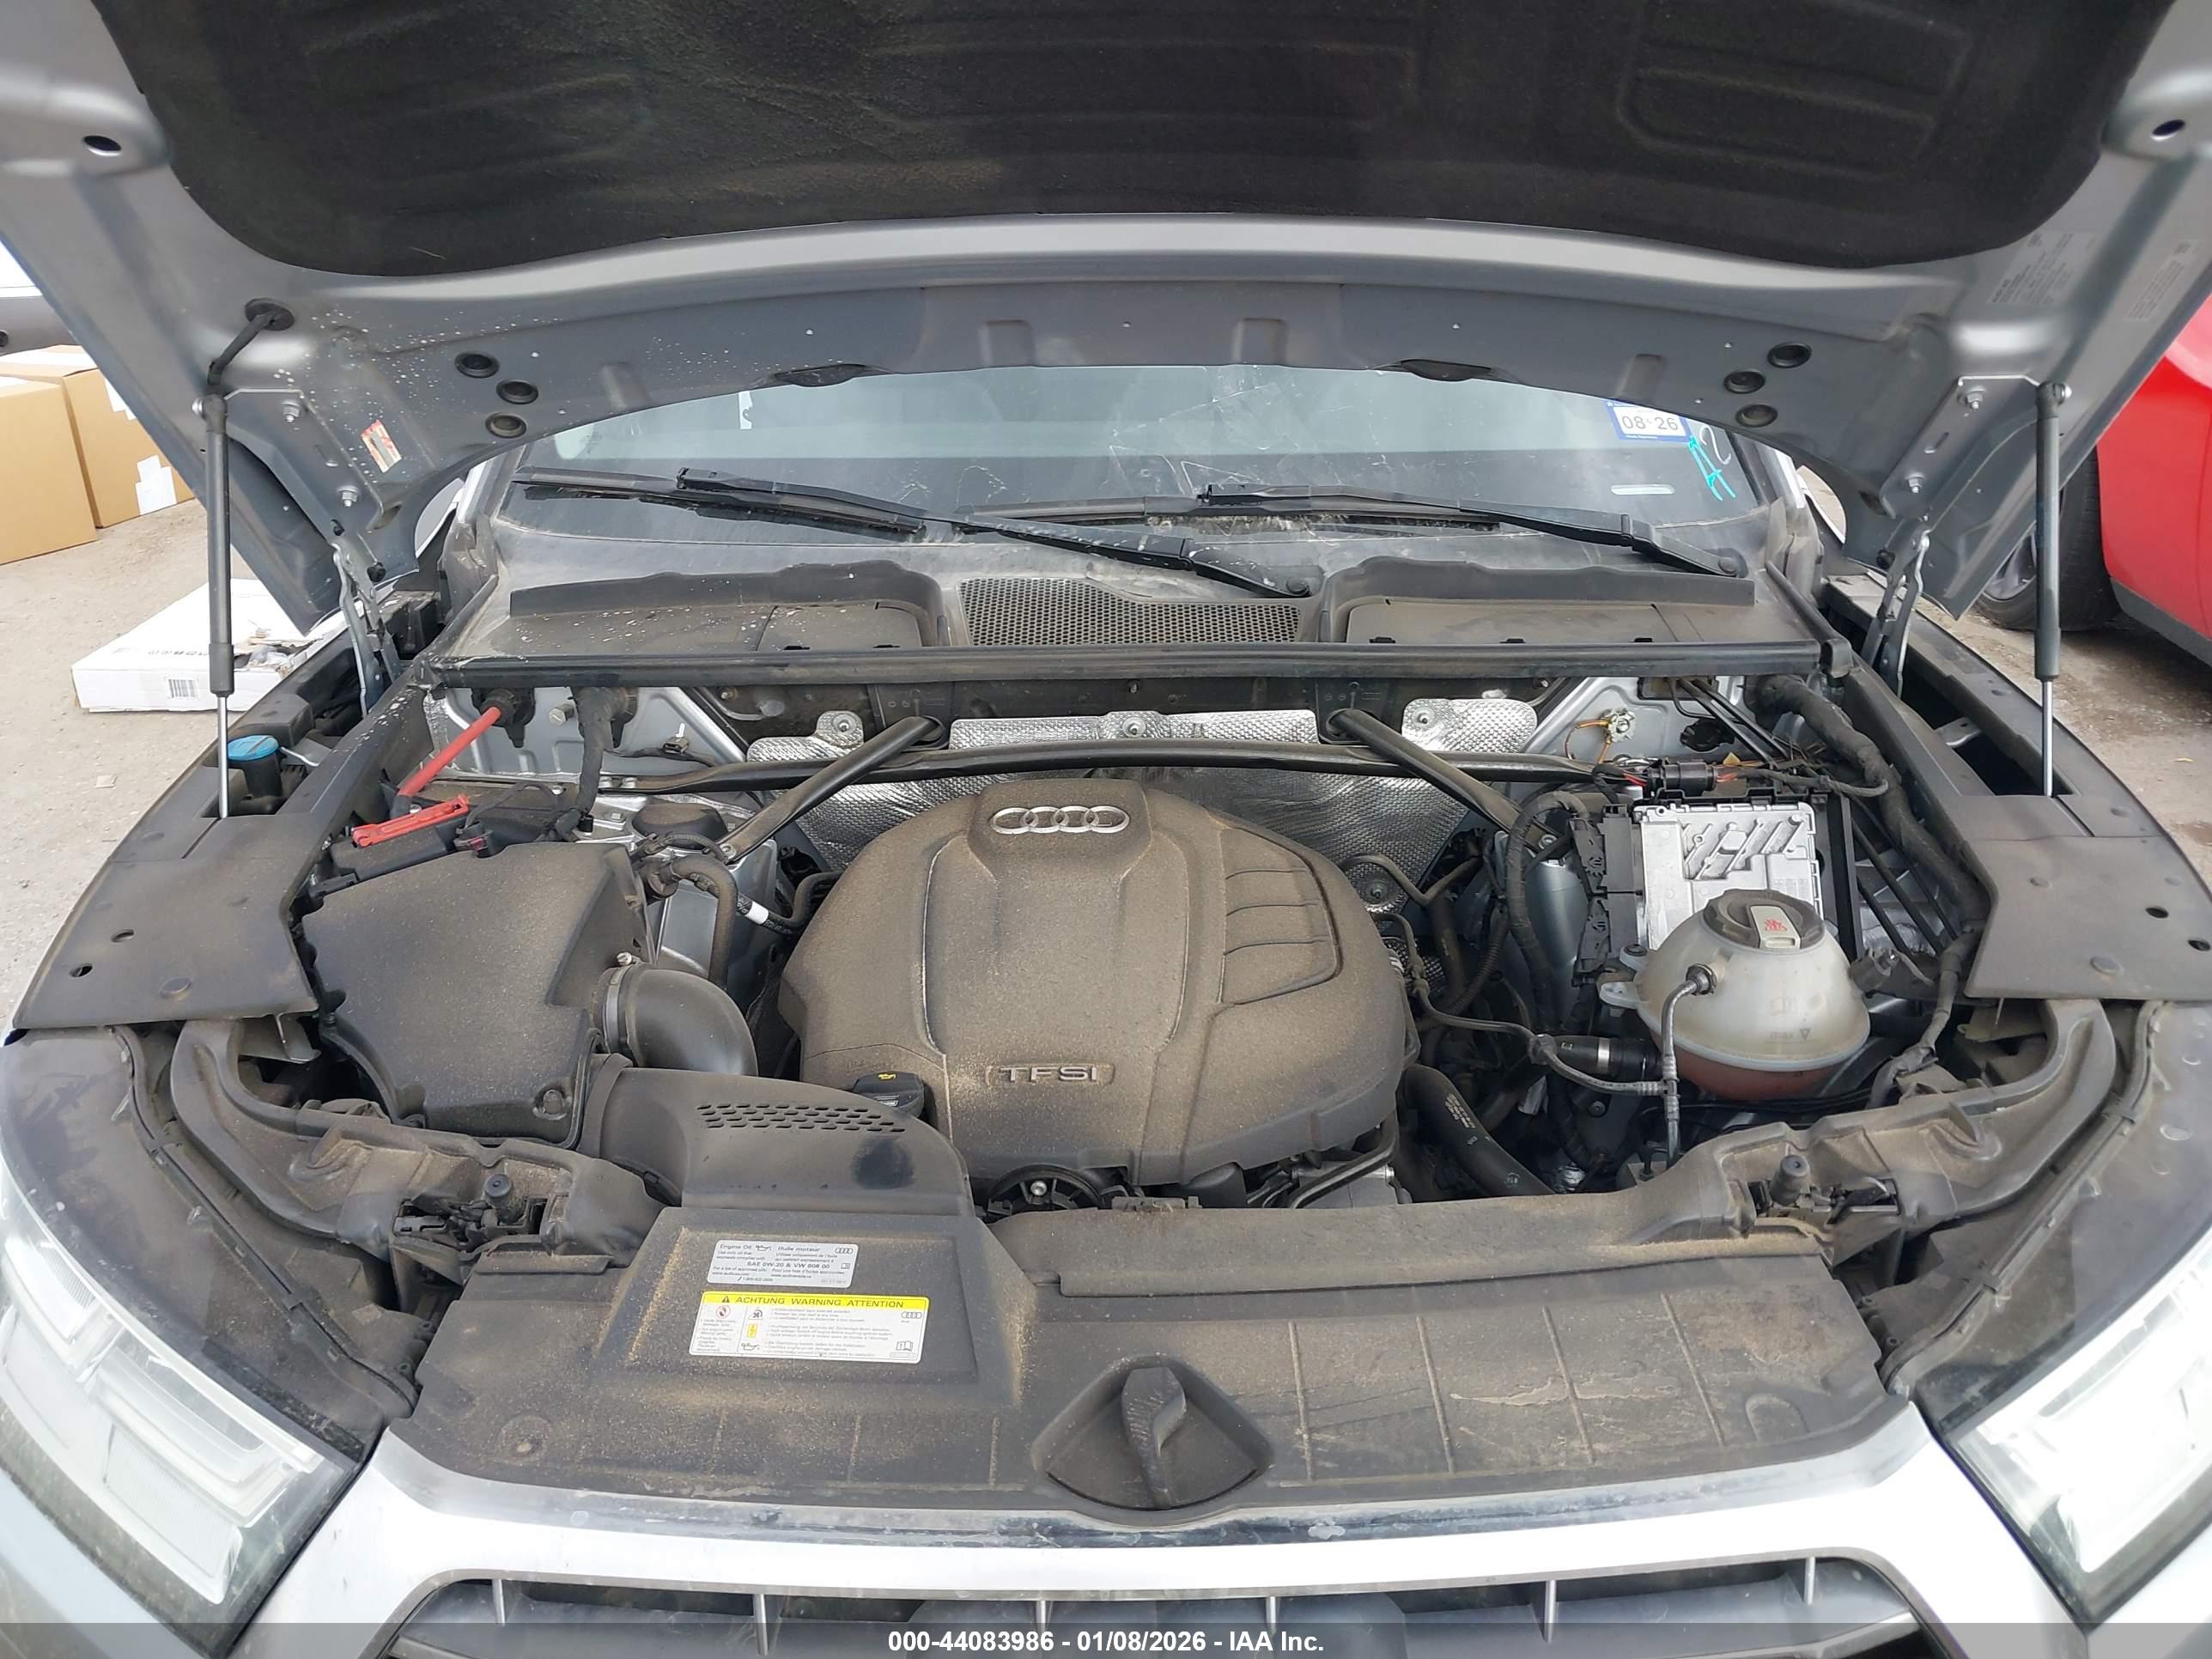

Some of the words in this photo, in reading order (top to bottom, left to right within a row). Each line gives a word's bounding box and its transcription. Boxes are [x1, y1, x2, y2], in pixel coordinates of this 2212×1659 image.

[1621, 416, 1646, 429] 08
[1654, 416, 1678, 430] 26
[1000, 1066, 1097, 1082] TFSI
[791, 1297, 842, 1306] WARNING
[847, 1299, 904, 1308] ATTENTION
